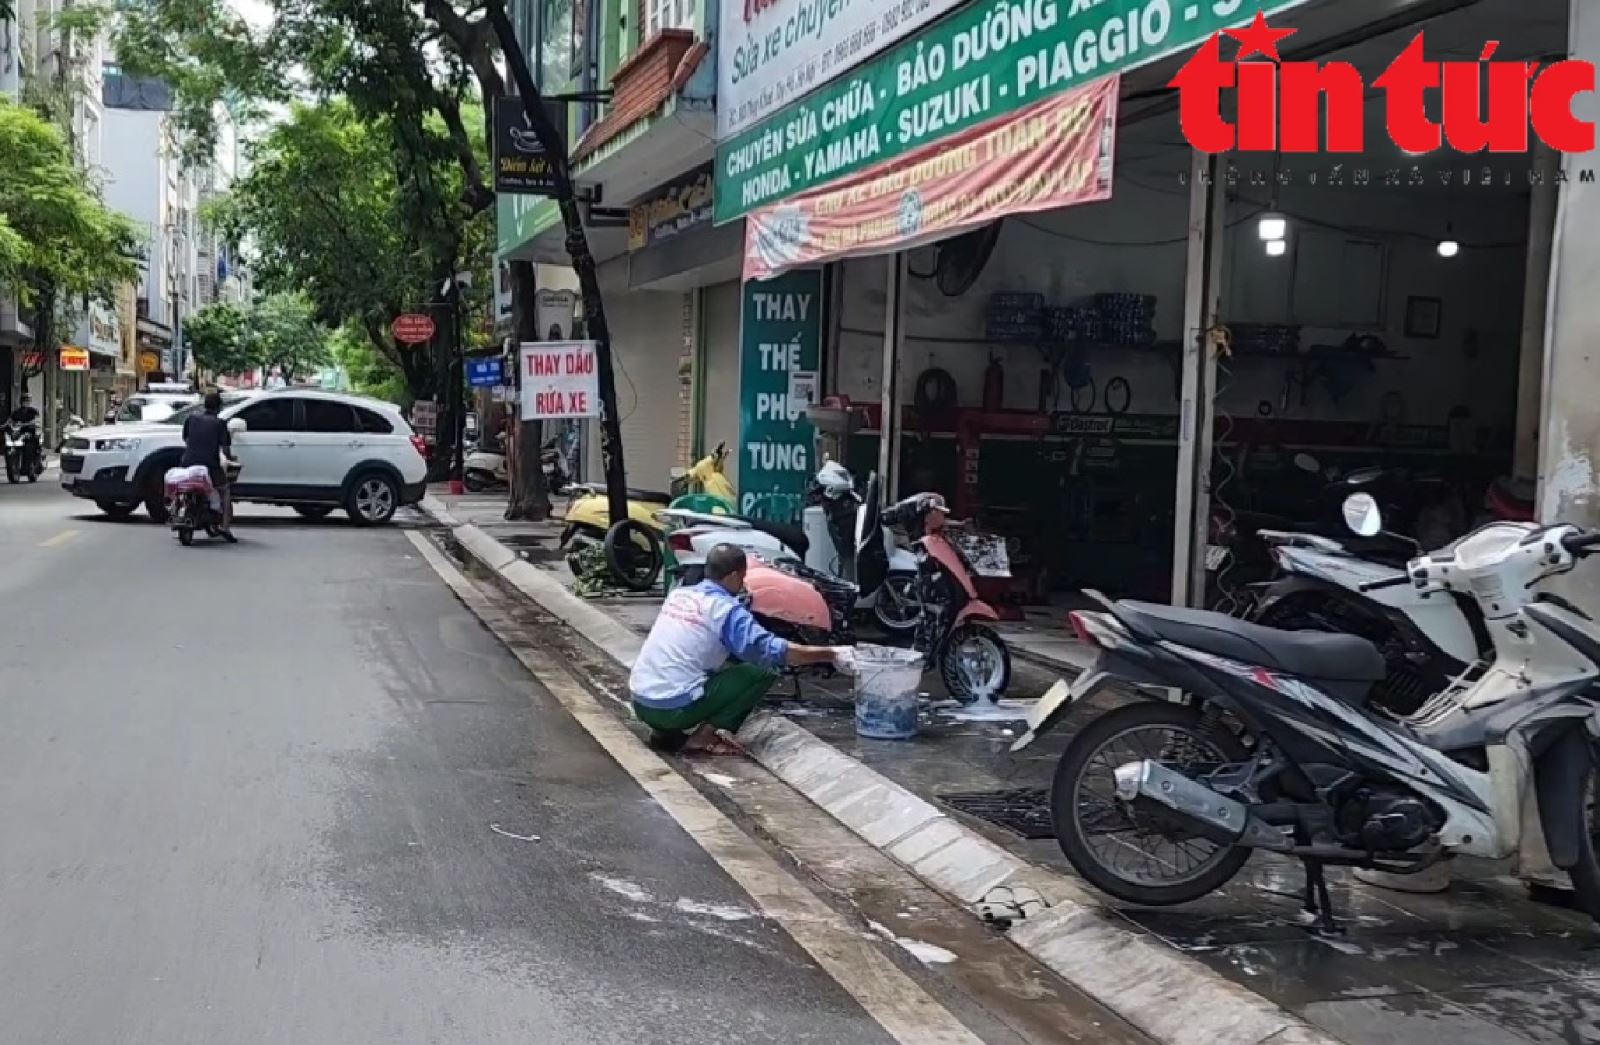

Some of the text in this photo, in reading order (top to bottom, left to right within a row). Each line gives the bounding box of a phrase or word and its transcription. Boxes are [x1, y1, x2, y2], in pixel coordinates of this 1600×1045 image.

[731, 32, 760, 84] Sửa
[761, 26, 782, 65] xe
[726, 127, 784, 177] CHUYÊN
[787, 106, 817, 150] SỬA
[822, 80, 875, 131] CHỮA
[896, 40, 945, 96] BẢO
[952, 0, 1058, 71] DƯỠNG
[742, 164, 791, 206] HONDA
[804, 124, 881, 180] YAMAHA
[898, 74, 990, 144] SUZUKI
[1017, 0, 1171, 97] PIAGGIO
[753, 293, 812, 321] THAY
[527, 354, 560, 376] THAY
[758, 331, 802, 371] THẾ
[569, 392, 587, 413] XE
[747, 437, 807, 471] TÙNG
